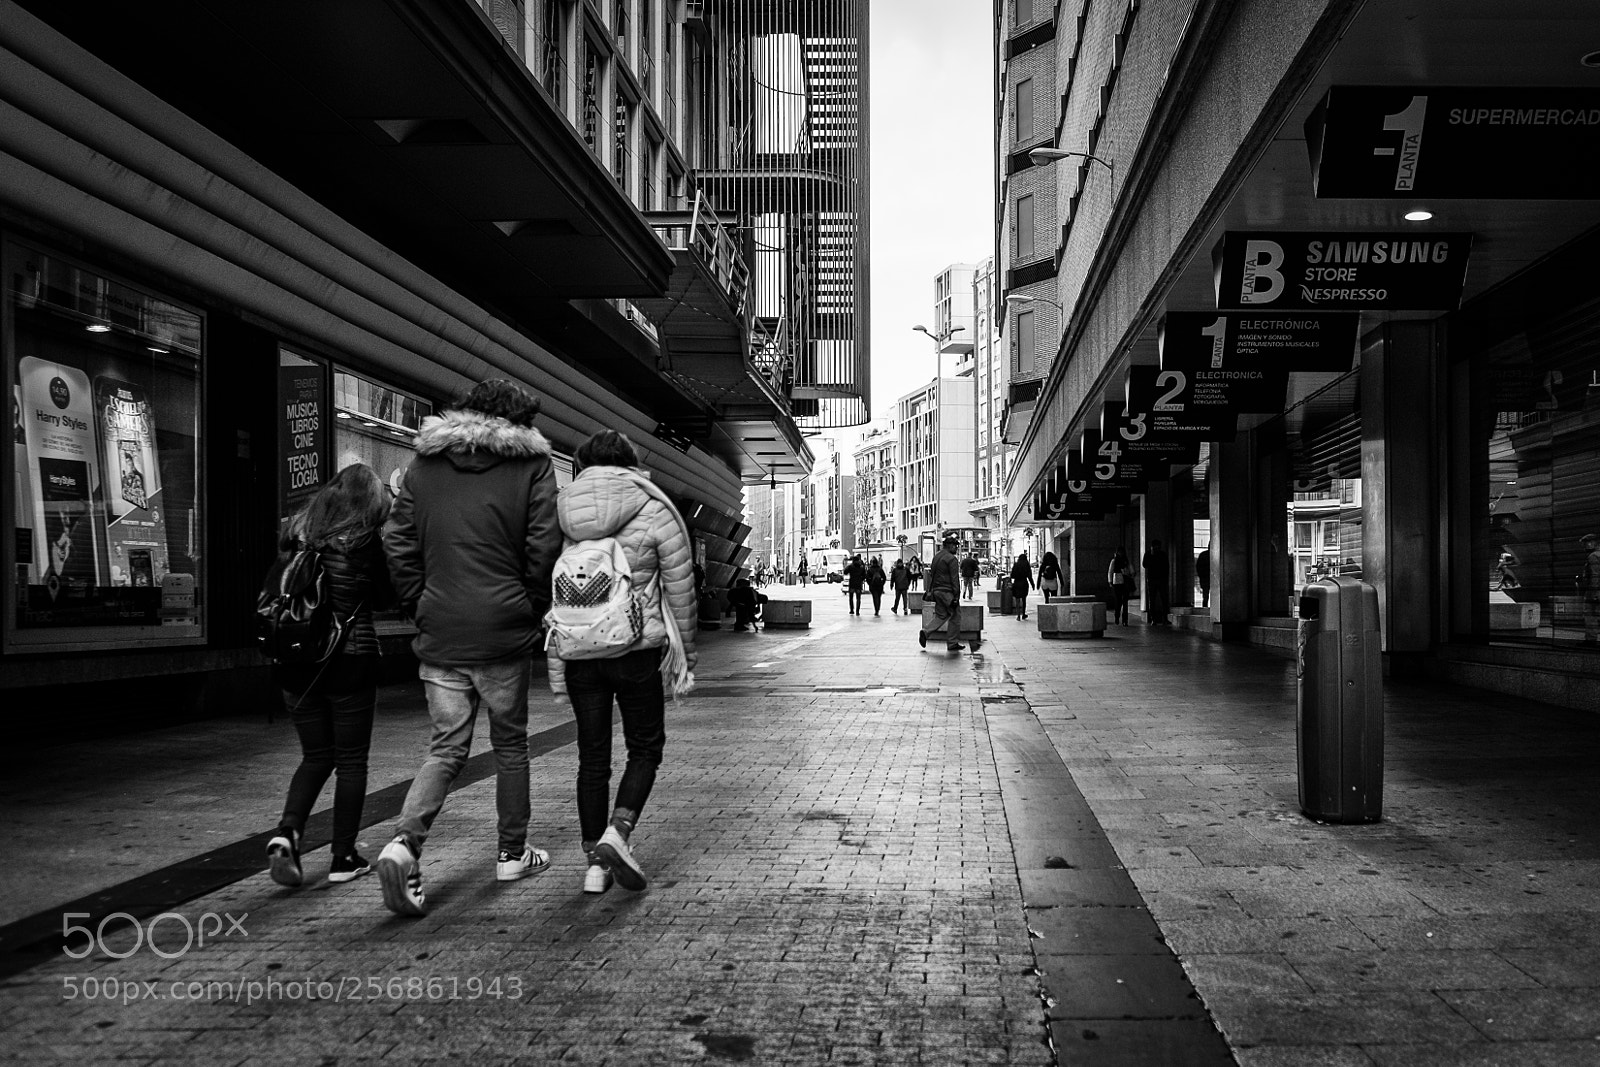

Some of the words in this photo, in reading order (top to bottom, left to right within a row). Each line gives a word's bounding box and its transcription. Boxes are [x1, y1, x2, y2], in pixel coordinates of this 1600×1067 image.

[1398, 134, 1420, 189] PLANTA
[1306, 240, 1449, 264] SAMSUNG
[1240, 239, 1285, 304] B
[1241, 258, 1257, 302] PLANTA
[1304, 267, 1358, 282] STORE
[1297, 284, 1388, 304] NESPRESSO
[1239, 318, 1320, 330] ELECTRÓNICA
[1201, 316, 1228, 368] 1
[1212, 336, 1224, 367] PLANTA
[1153, 370, 1187, 411] 2
[36, 409, 61, 427] Harry
[61, 415, 88, 431] Styles
[286, 399, 319, 420] MÚSICA
[291, 417, 319, 434] LIBROS
[1119, 407, 1147, 441] 3
[294, 432, 314, 449] CINE
[287, 452, 319, 473] TECNO
[1097, 441, 1122, 463] 4
[291, 468, 319, 489] LOGIA
